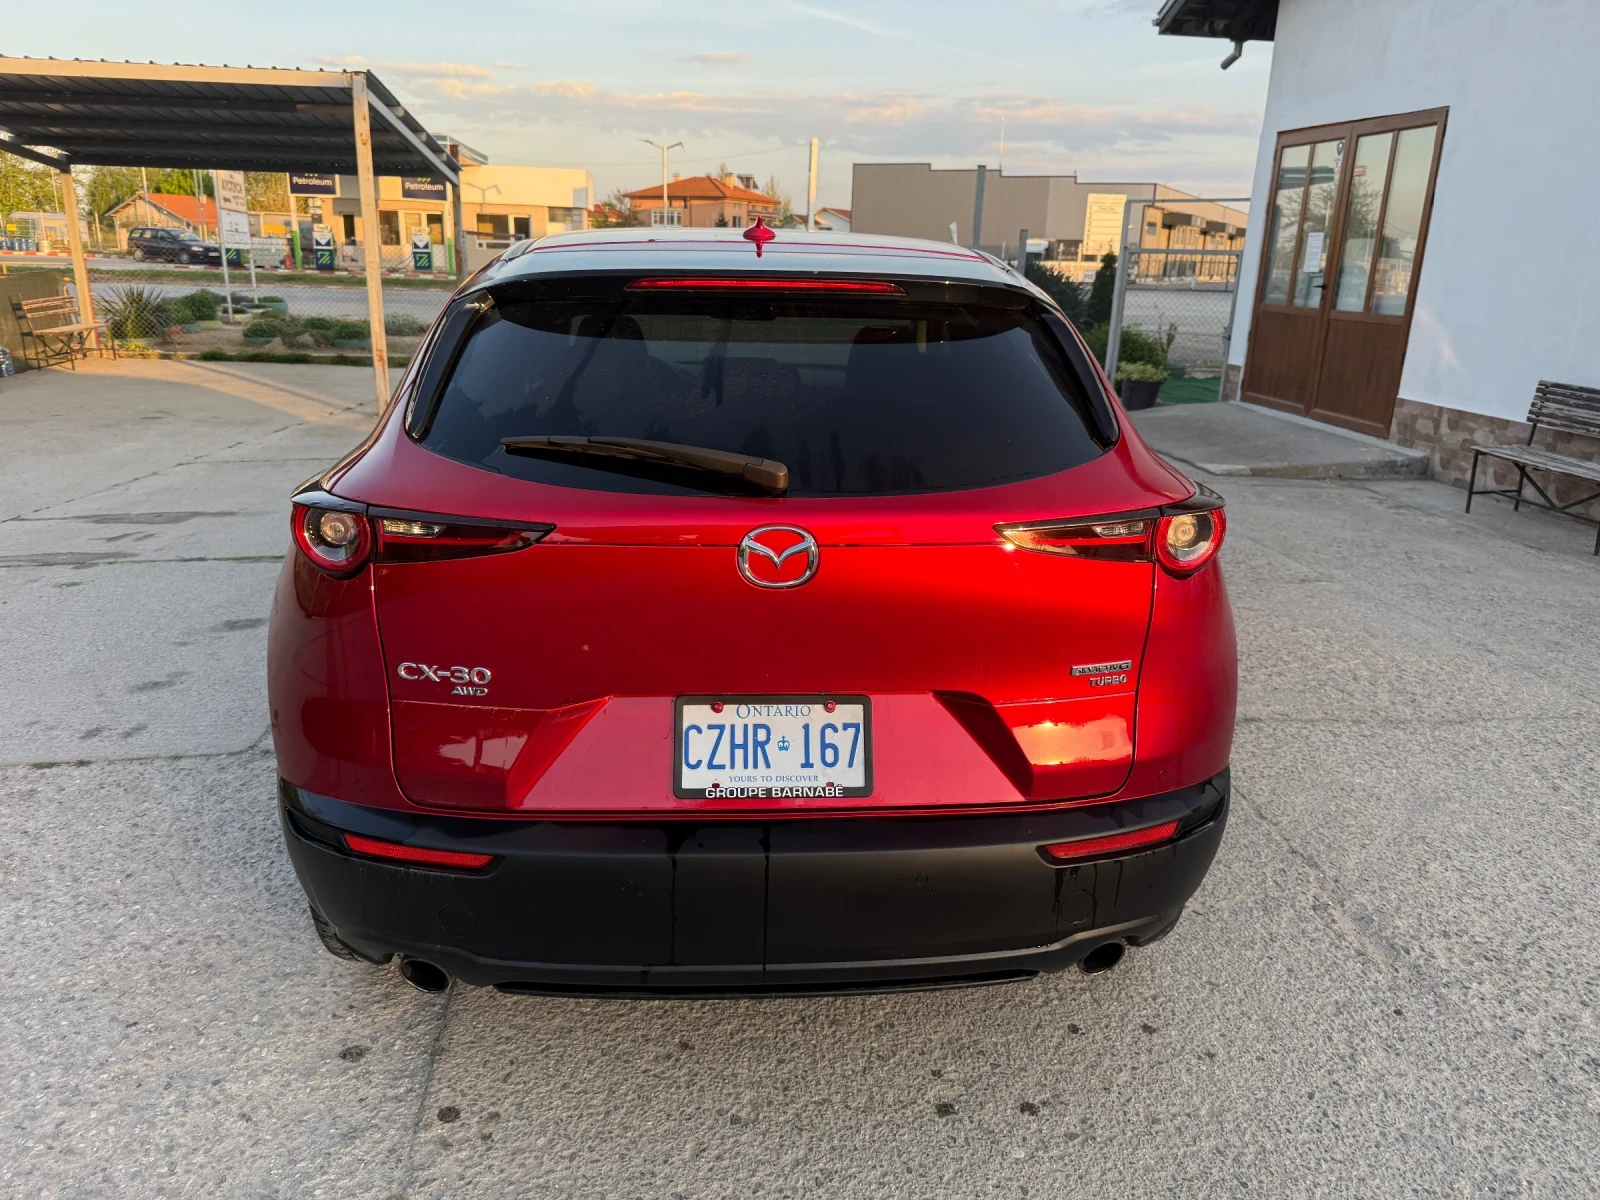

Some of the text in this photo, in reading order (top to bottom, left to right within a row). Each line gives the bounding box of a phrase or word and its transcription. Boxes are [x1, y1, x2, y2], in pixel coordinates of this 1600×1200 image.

[292, 176, 333, 186] Petroleum
[404, 181, 444, 191] Petroleum
[397, 662, 492, 685] CX-30
[1089, 674, 1127, 687] TURBO
[450, 686, 489, 696] AWD
[683, 723, 861, 770] CZHR 167
[728, 775, 819, 783] YOURS TO DISCOVER
[705, 787, 767, 798] GROUPE
